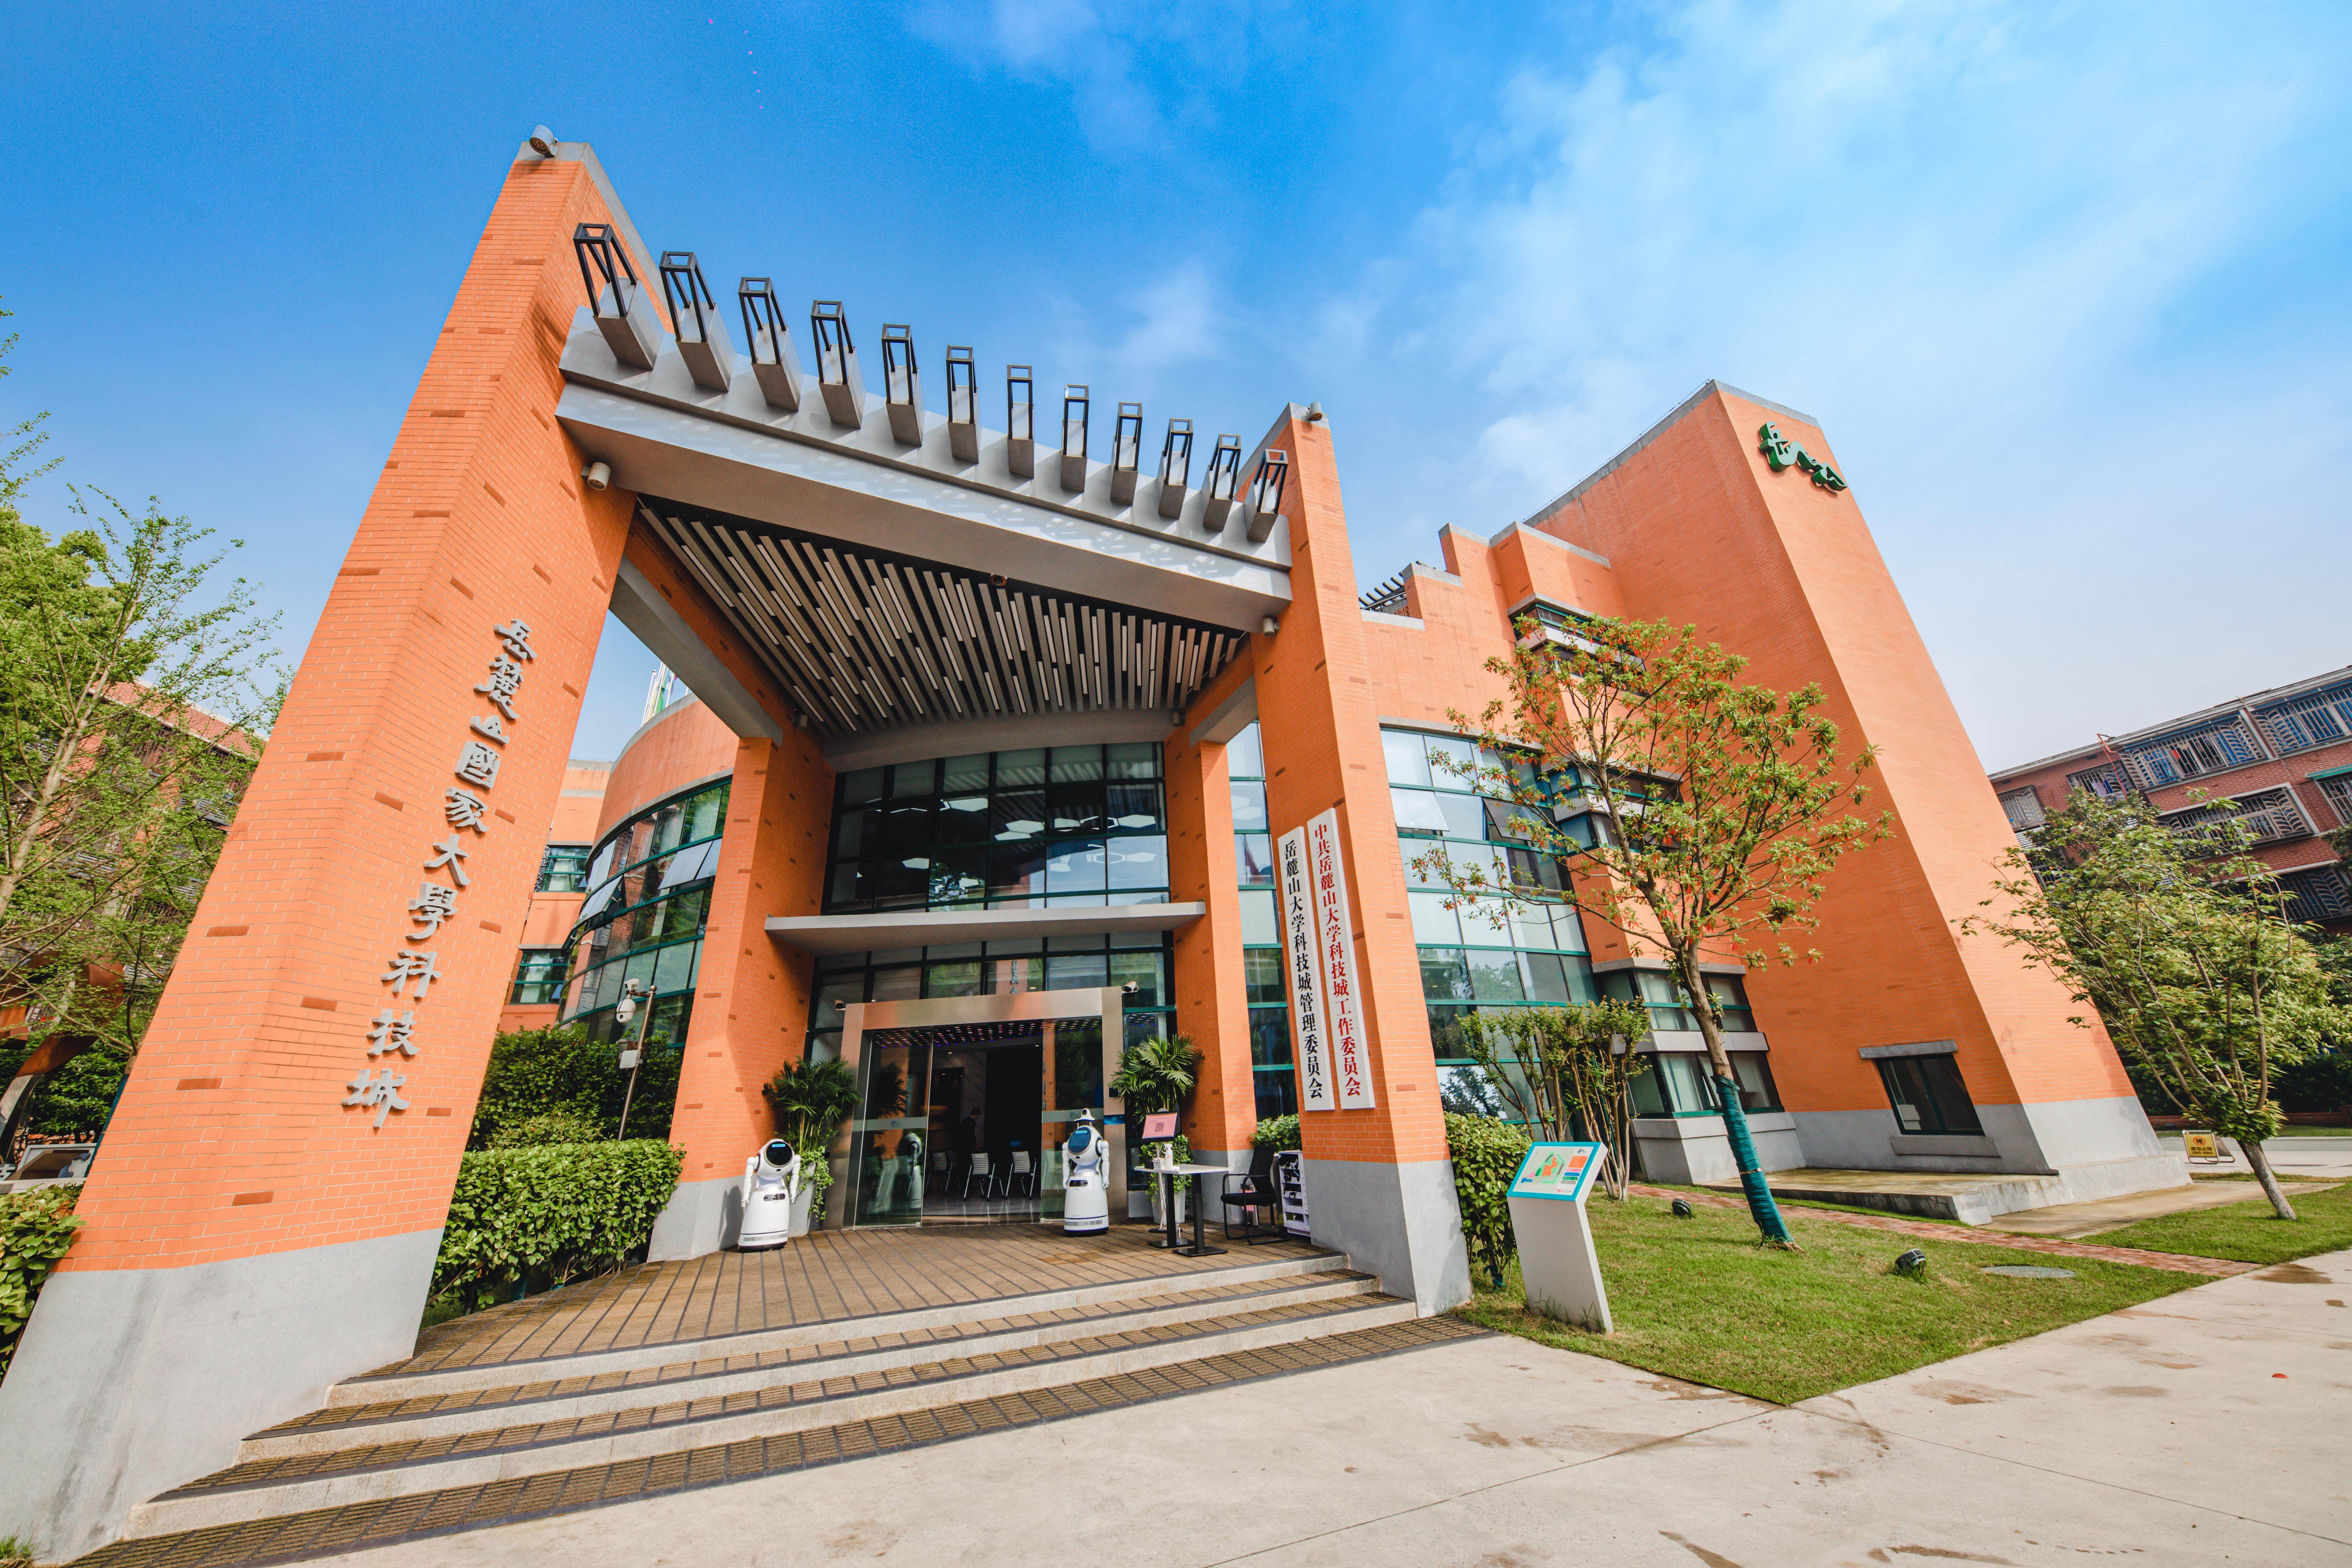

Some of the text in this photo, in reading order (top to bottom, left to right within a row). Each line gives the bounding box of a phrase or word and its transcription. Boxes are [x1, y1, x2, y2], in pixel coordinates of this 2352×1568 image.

[1284, 840, 1322, 1099] 岳麓山大学科技城管理委员会
[1314, 824, 1361, 1097] 中共岳麓山大学科技城工作委员会
